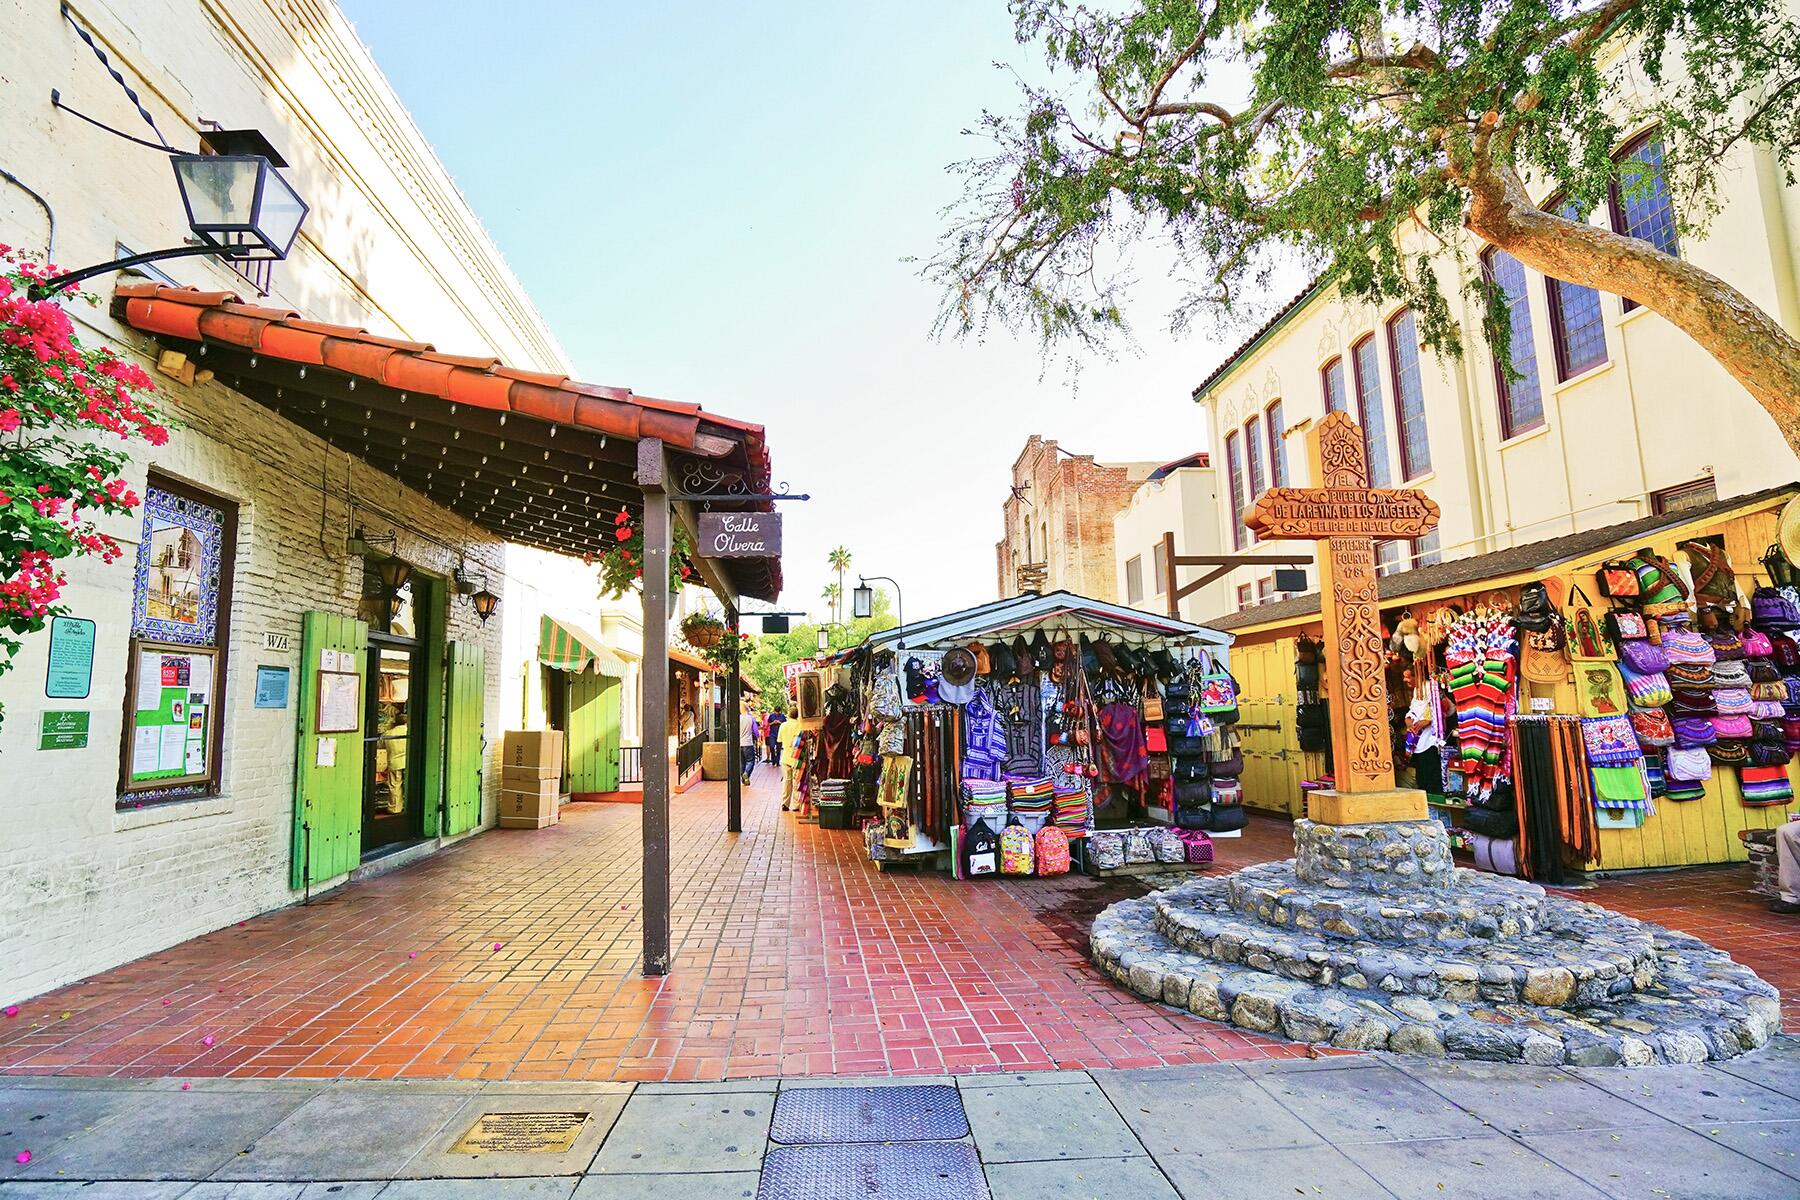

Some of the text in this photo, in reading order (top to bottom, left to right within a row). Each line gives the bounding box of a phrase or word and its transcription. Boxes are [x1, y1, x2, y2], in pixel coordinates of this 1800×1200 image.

[1338, 474, 1352, 487] EL
[1331, 490, 1366, 502] PUEBLO
[1274, 504, 1288, 519] DE
[1305, 504, 1338, 519] REYNA
[1340, 504, 1354, 519] DE
[1354, 504, 1375, 519] LOS
[1376, 504, 1421, 519] ANGELES
[722, 515, 760, 532] Calle
[1310, 521, 1388, 532] FELIPE DE NEVE
[714, 533, 766, 552] Olvera
[1331, 540, 1371, 551] SEPTEMBER
[1336, 553, 1369, 564] FOURTH
[1344, 567, 1365, 578] 1781
